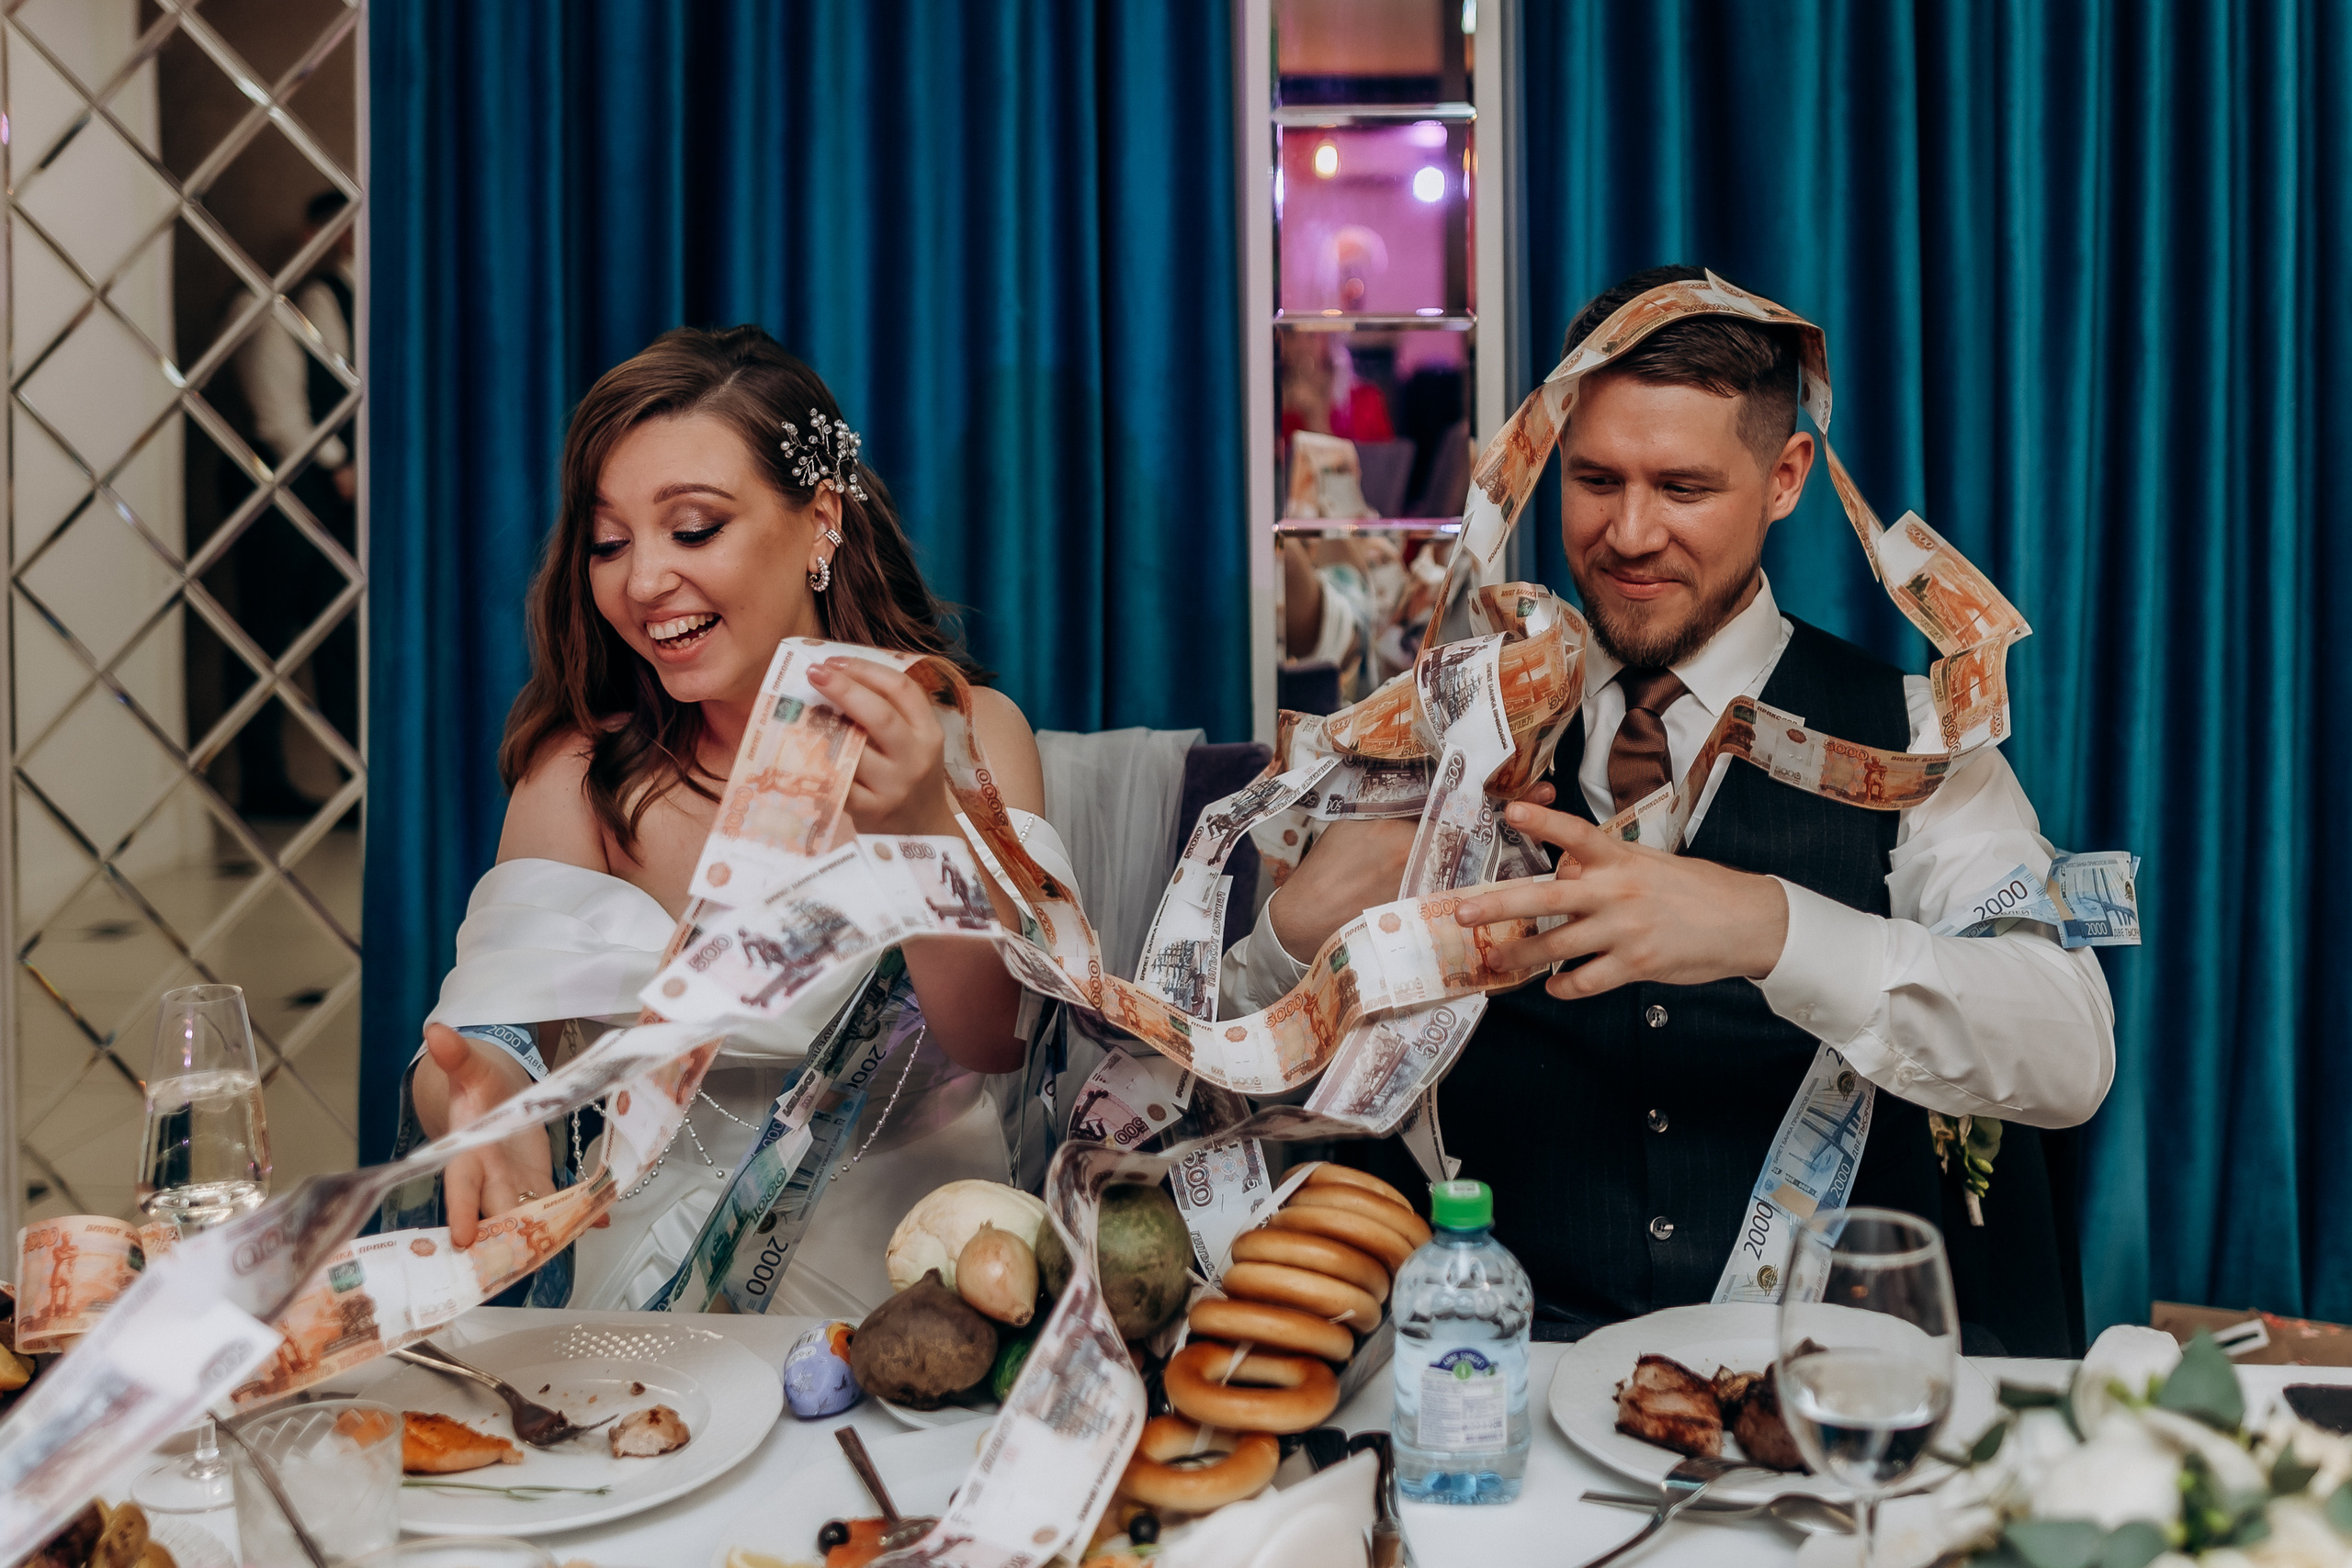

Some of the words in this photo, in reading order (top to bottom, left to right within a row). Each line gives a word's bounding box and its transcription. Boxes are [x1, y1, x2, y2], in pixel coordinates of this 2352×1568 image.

[1906, 524, 1935, 550] 5000
[760, 695, 775, 726] БАНКА
[773, 649, 794, 692] ПРИКОЛОВ
[1822, 739, 1869, 761] 5000
[1444, 754, 1463, 788] 500
[1637, 792, 1669, 815] ПРИКОЛОВ
[899, 841, 936, 860] 500
[1183, 826, 1204, 860] 500
[1973, 879, 2029, 921] 2000
[2085, 921, 2108, 936] 2000
[2114, 928, 2124, 939] ДВЕ
[688, 933, 734, 973] 500
[1088, 960, 1103, 1009] 000
[1191, 1021, 1214, 1032] ПРИК
[1264, 993, 1304, 1029] 5000
[485, 1024, 522, 1048] 2000
[1411, 1005, 1457, 1059] 500
[524, 1054, 544, 1072] ДВЕ
[1114, 1116, 1149, 1145] 500
[1772, 1144, 1784, 1164] БИЛЕТ
[1781, 1127, 1794, 1145] БАНКА
[1792, 1096, 1810, 1130] ПРИКОЛОВ
[1852, 1140, 1862, 1161] ДВЕ
[1859, 1100, 1874, 1138] ТЫСЯЧИ
[1183, 1147, 1215, 1208] 500
[1830, 1162, 1851, 1199] 2000
[750, 1167, 788, 1224] 1000
[84, 1223, 121, 1235] БИЛЕТ
[475, 1217, 518, 1242] 000
[1743, 1201, 1774, 1261] 2000
[357, 1239, 398, 1255] ПРИКО
[744, 1235, 790, 1297] 2000
